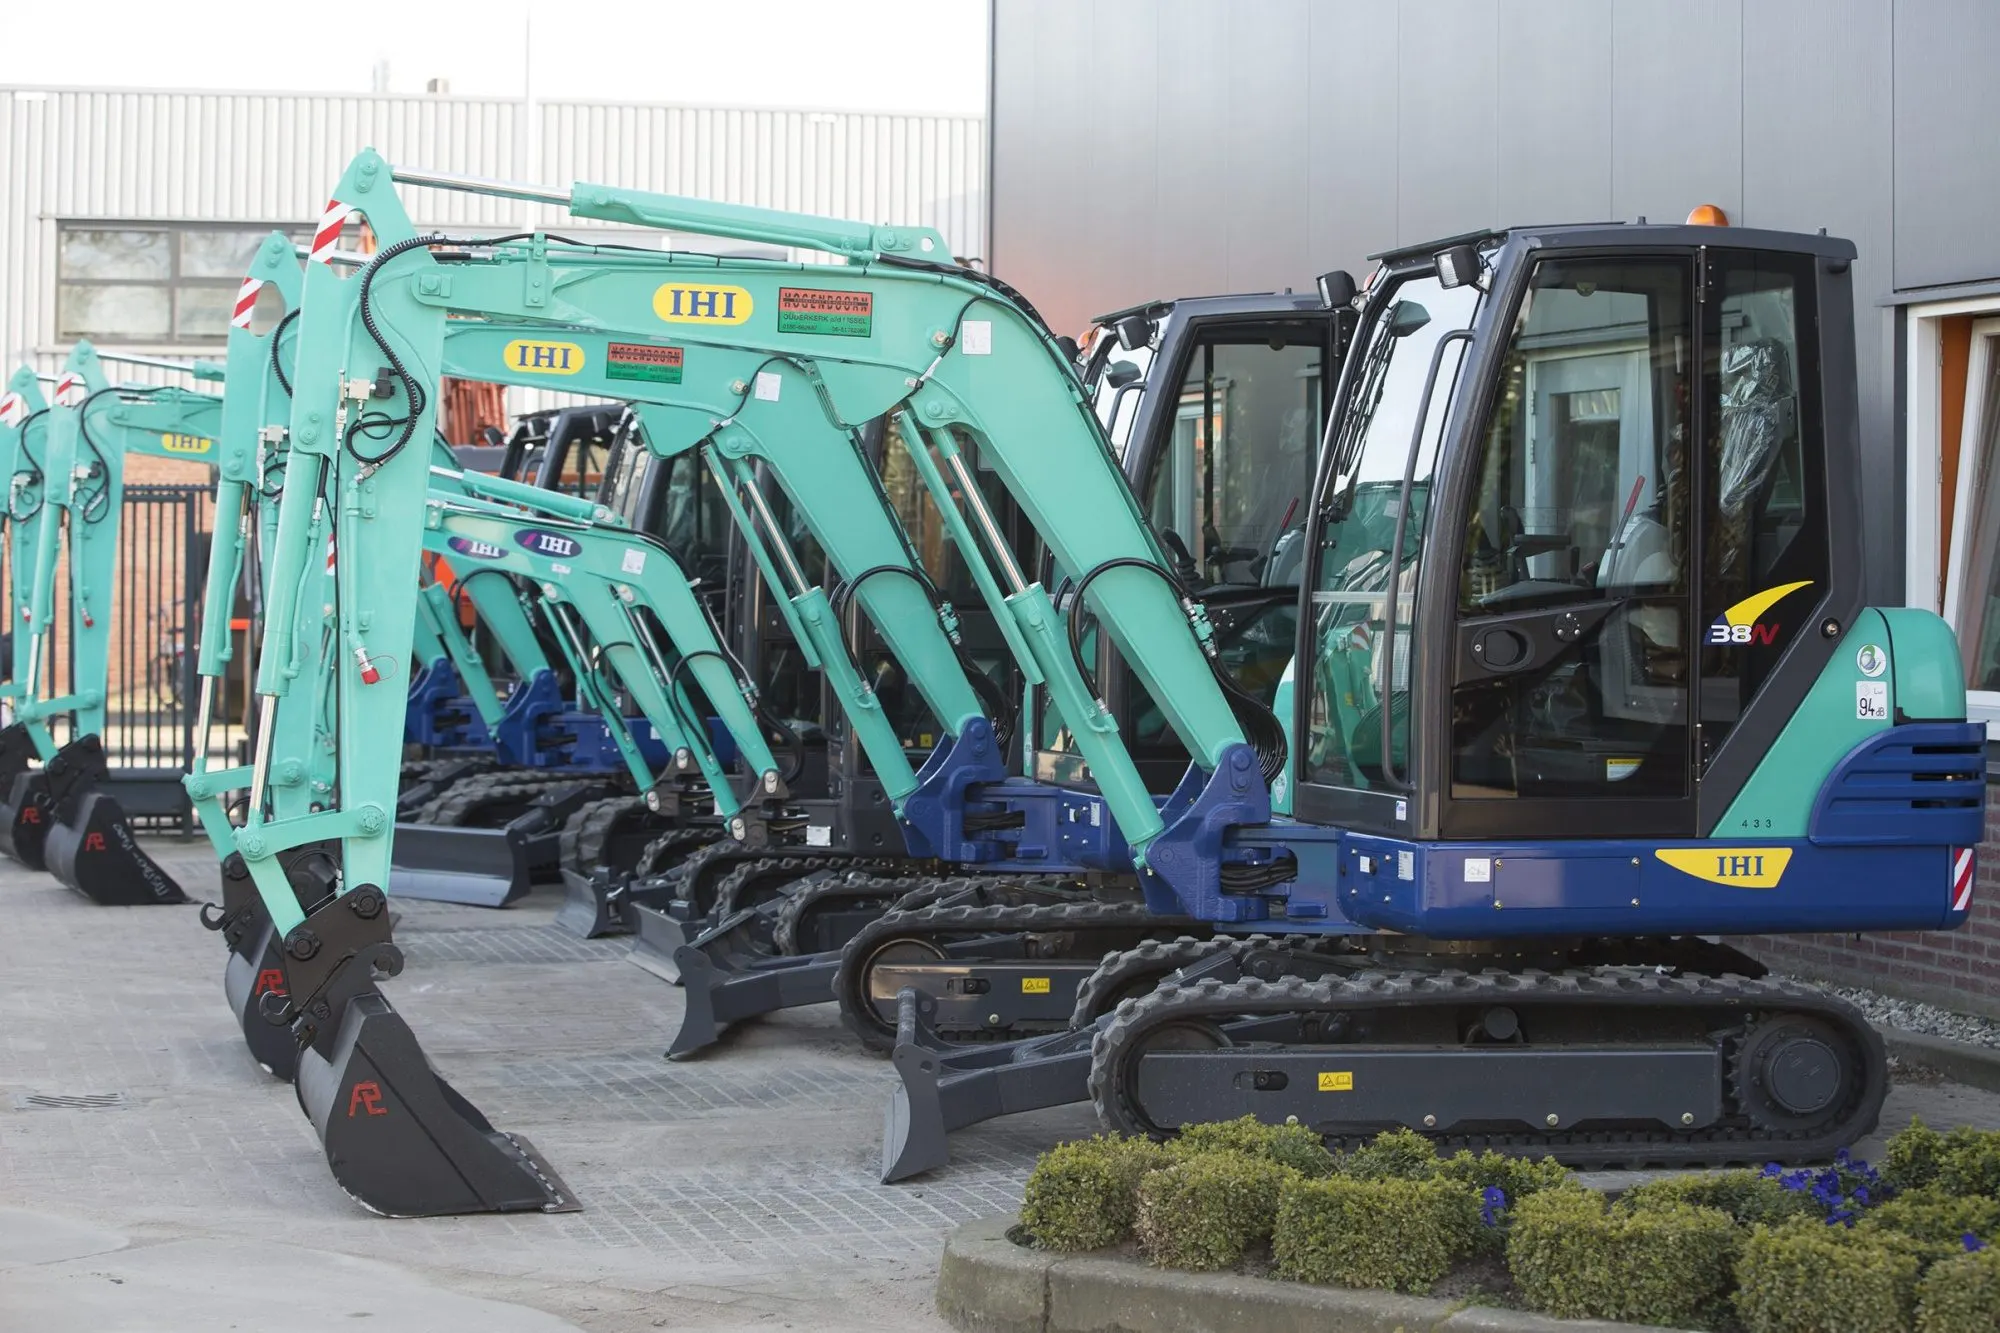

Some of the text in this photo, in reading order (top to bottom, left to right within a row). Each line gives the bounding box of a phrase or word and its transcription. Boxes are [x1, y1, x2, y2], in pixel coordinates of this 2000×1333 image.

[669, 289, 737, 319] IHI
[783, 292, 868, 312] HOGENDOORN
[517, 345, 571, 369] IHI
[171, 433, 203, 449] IHI
[469, 540, 501, 557] IHI
[538, 534, 574, 556] IHI
[1859, 697, 1875, 717] 94
[1716, 855, 1764, 877] IHI
